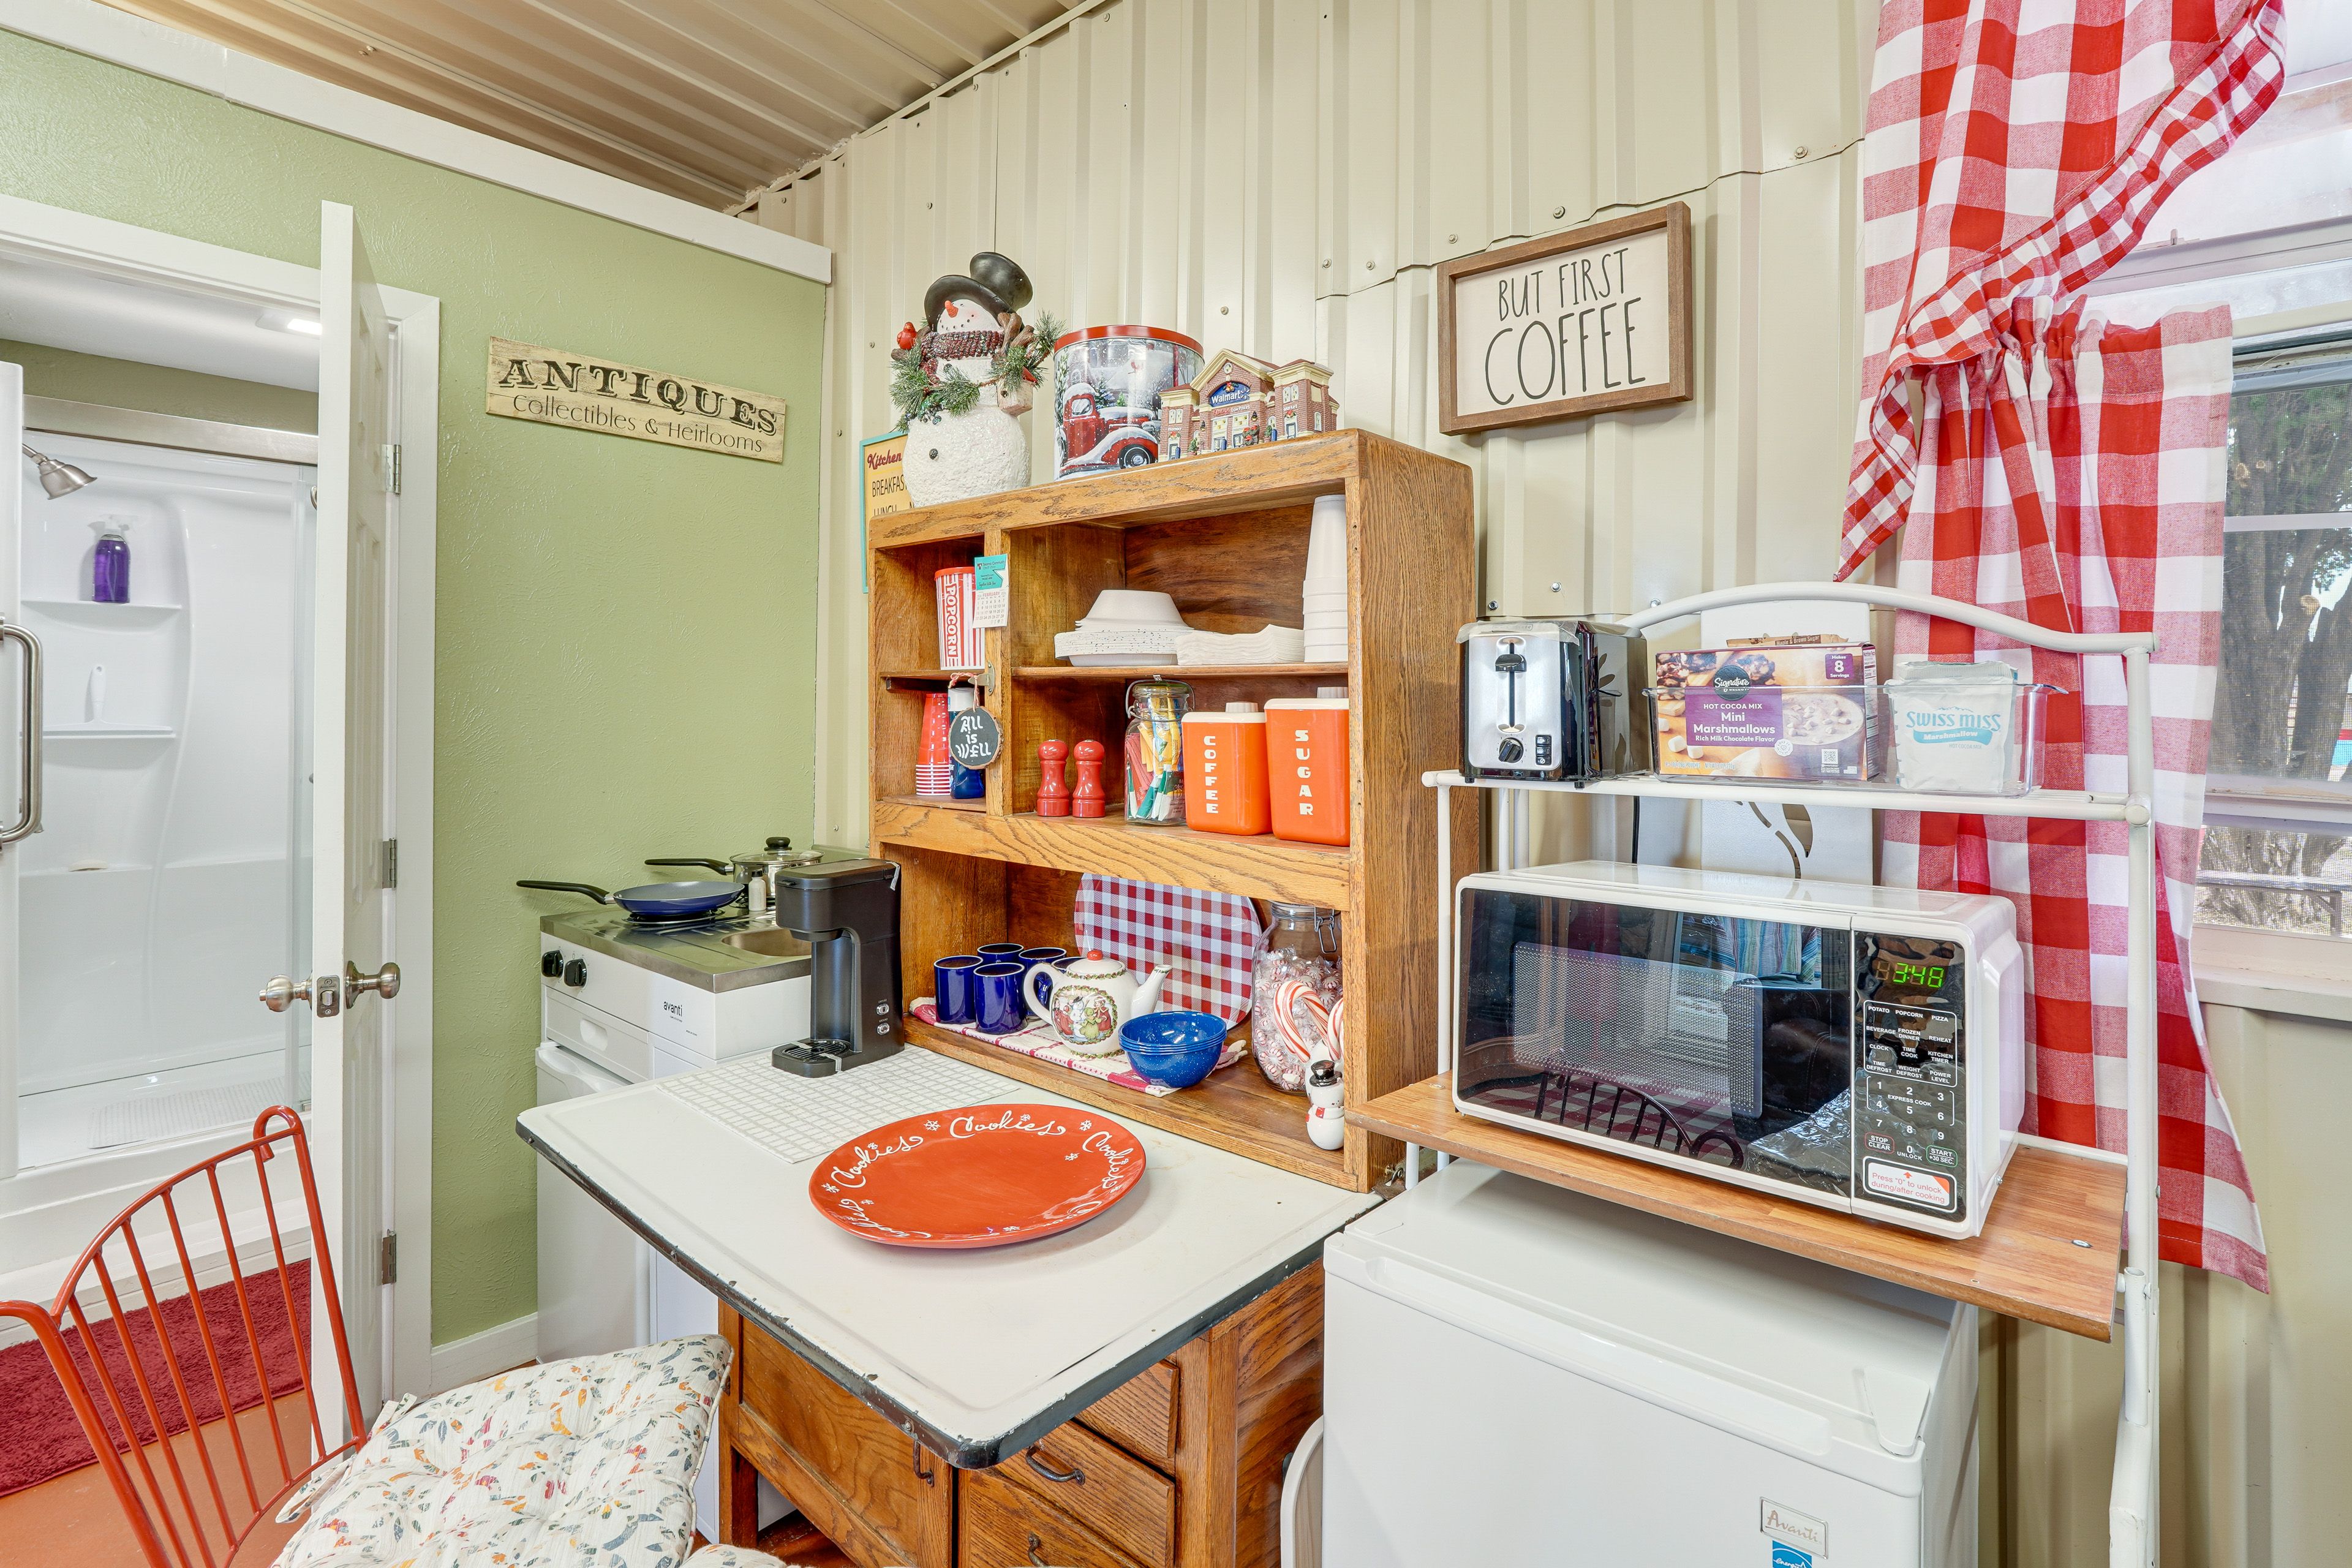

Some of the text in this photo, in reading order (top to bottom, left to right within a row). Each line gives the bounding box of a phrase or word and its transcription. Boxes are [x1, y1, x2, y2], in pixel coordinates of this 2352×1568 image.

[1499, 248, 1628, 321] BUT FIRST
[1485, 297, 1645, 405] COFFEE
[498, 359, 777, 436] ANTIQUES
[1212, 390, 1241, 404] Walmart
[513, 394, 762, 453] Collectibles & Heirlooms
[867, 449, 902, 470] Kitchen
[945, 582, 959, 657] POPCORN
[1834, 660, 1844, 673] 8
[1714, 677, 1750, 692] Signature
[1721, 712, 1745, 722] Mini
[1694, 723, 1775, 734] Marshmallows
[1923, 731, 1978, 741] Marshmallow
[1204, 736, 1218, 813] COFFEE
[1295, 729, 1313, 815] SUGAR
[1893, 962, 1944, 987] 3:48
[663, 1001, 682, 1017] avanti
[1866, 1026, 1896, 1035] BEVERAGE
[1896, 1070, 1923, 1079] DEFROST
[1888, 1095, 1913, 1103] EXPRESS
[949, 1110, 1066, 1139] Cookies
[1869, 1142, 1890, 1150] CLEAR
[1897, 1152, 1922, 1161] UNLOCK
[830, 1136, 924, 1189] Cookies
[1082, 1131, 1134, 1190] Cookies
[1871, 1181, 1945, 1204] during/after cooking
[1872, 1172, 1893, 1183] Press
[1917, 1183, 1942, 1194] unlock
[1767, 1510, 1819, 1542] Avanti
